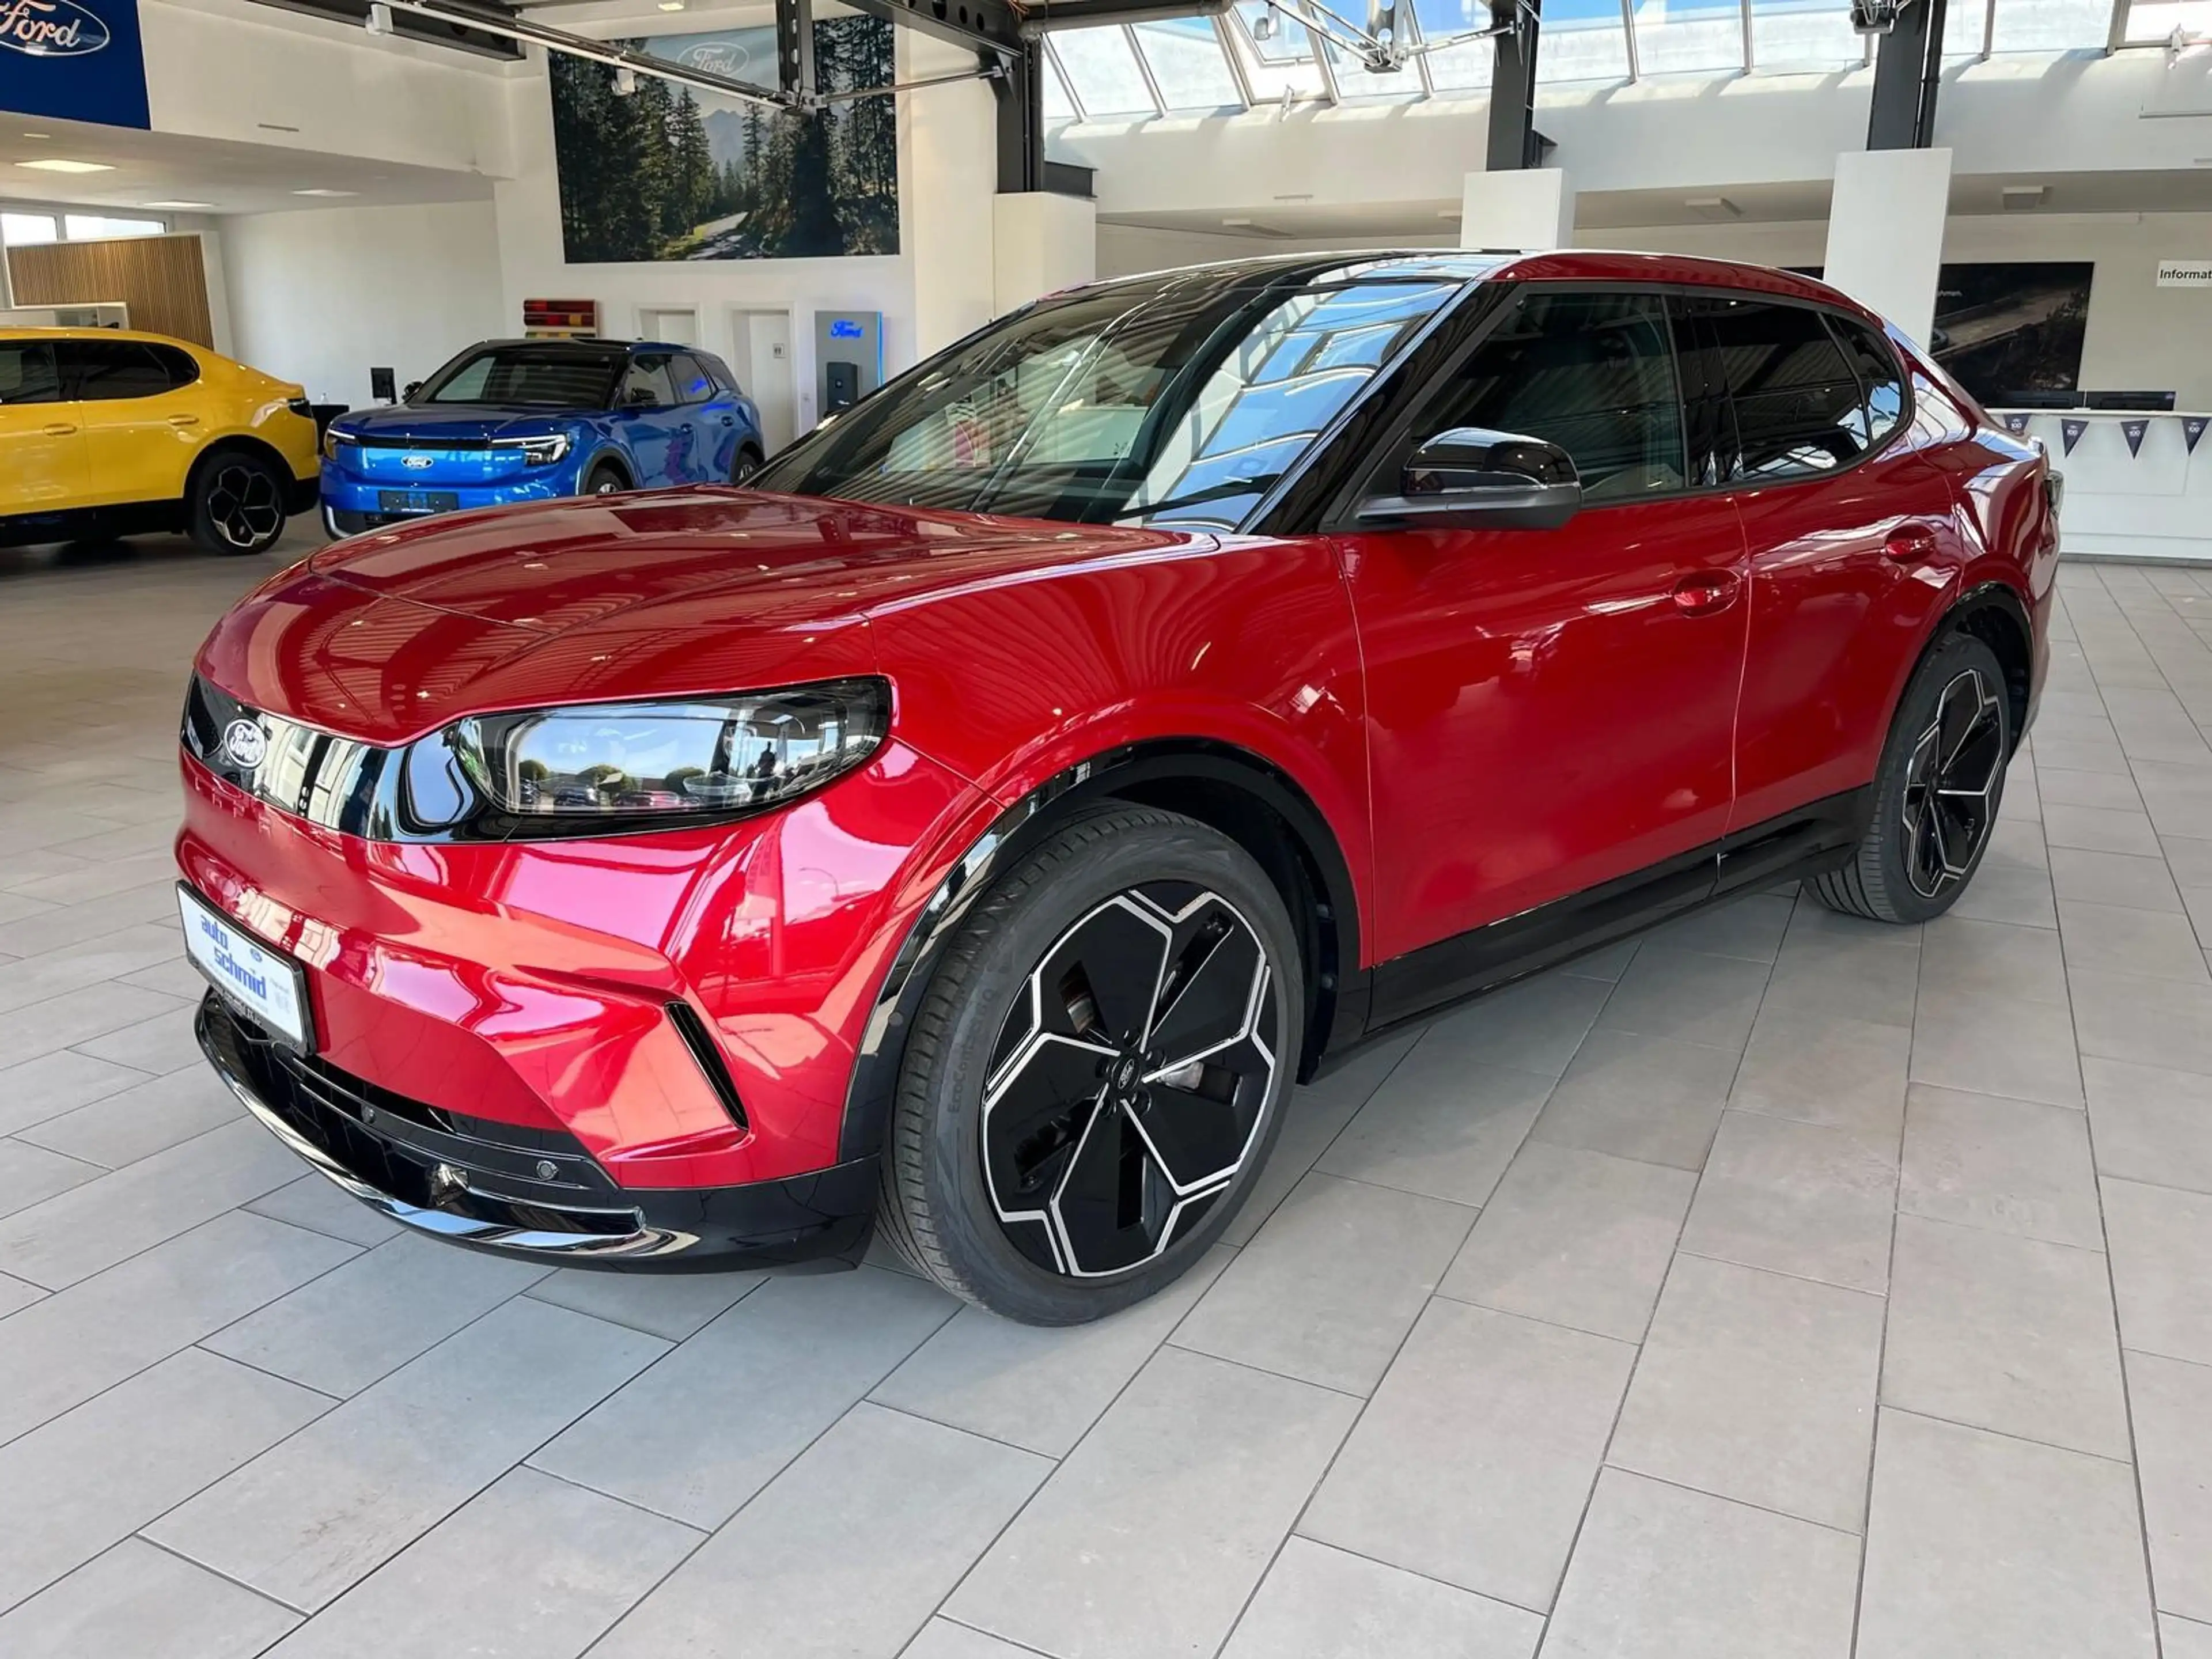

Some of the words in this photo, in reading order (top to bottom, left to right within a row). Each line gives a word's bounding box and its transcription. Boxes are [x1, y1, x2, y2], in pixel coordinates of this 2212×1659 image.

[0, 0, 81, 47] Ford
[692, 48, 738, 73] Ford
[200, 914, 229, 950] auto
[214, 946, 267, 1000] schmid
